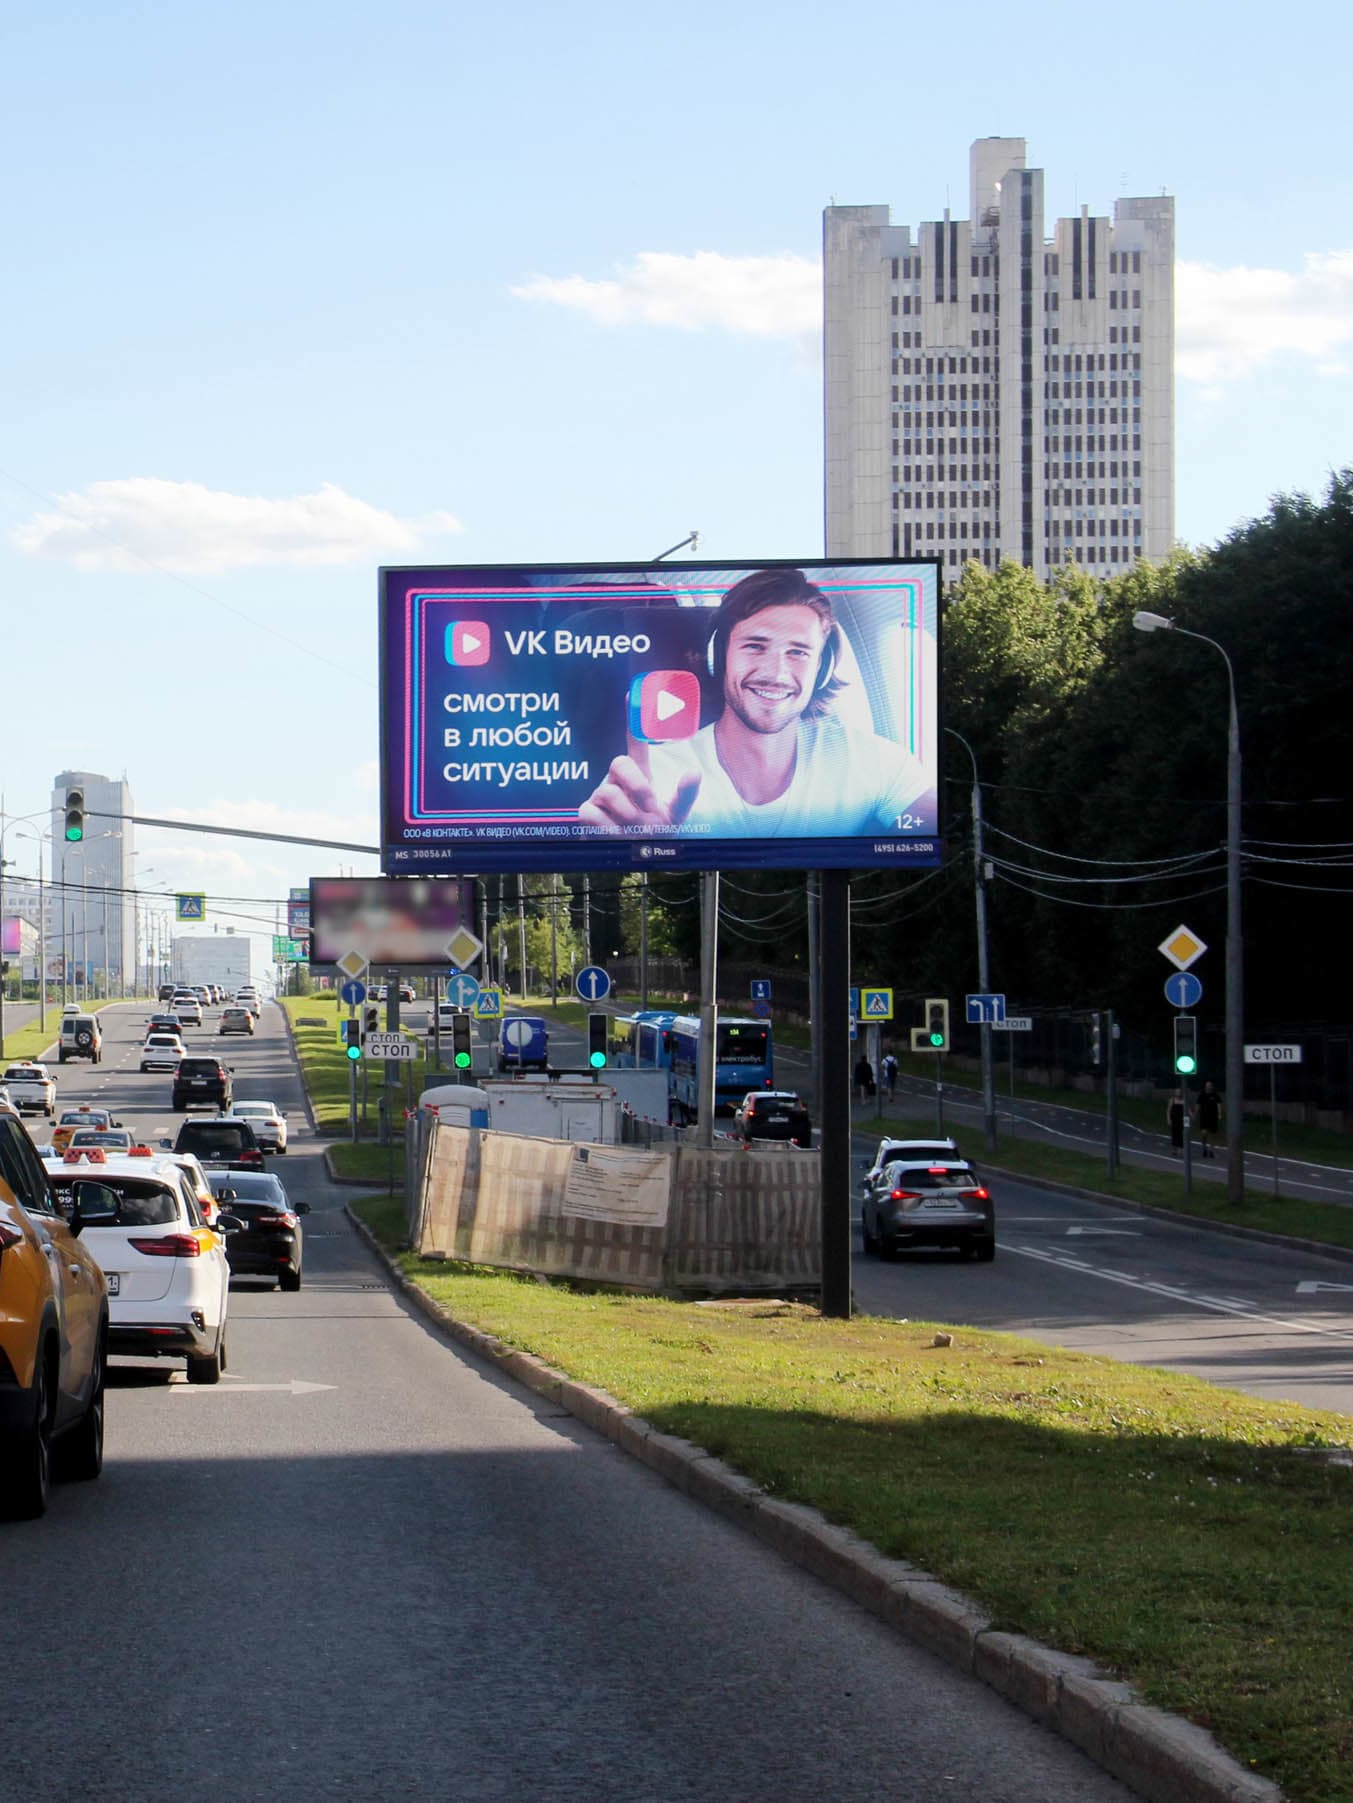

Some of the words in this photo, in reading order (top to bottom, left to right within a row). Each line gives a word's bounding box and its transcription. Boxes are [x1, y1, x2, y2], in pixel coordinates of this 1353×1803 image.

[504, 630, 547, 655] VK
[554, 630, 651, 658] Видео
[443, 692, 560, 718] смотри
[444, 728, 461, 747] в
[469, 721, 572, 747] любой
[443, 760, 589, 788] ситуации
[895, 814, 924, 829] 12+
[403, 828, 421, 838] ООО
[475, 827, 486, 837] VK
[395, 850, 408, 860] MS
[653, 847, 676, 856] Russ
[370, 1034, 400, 1043] СТОП
[371, 1044, 410, 1056] СТОП
[1252, 1048, 1293, 1060] СТОП
